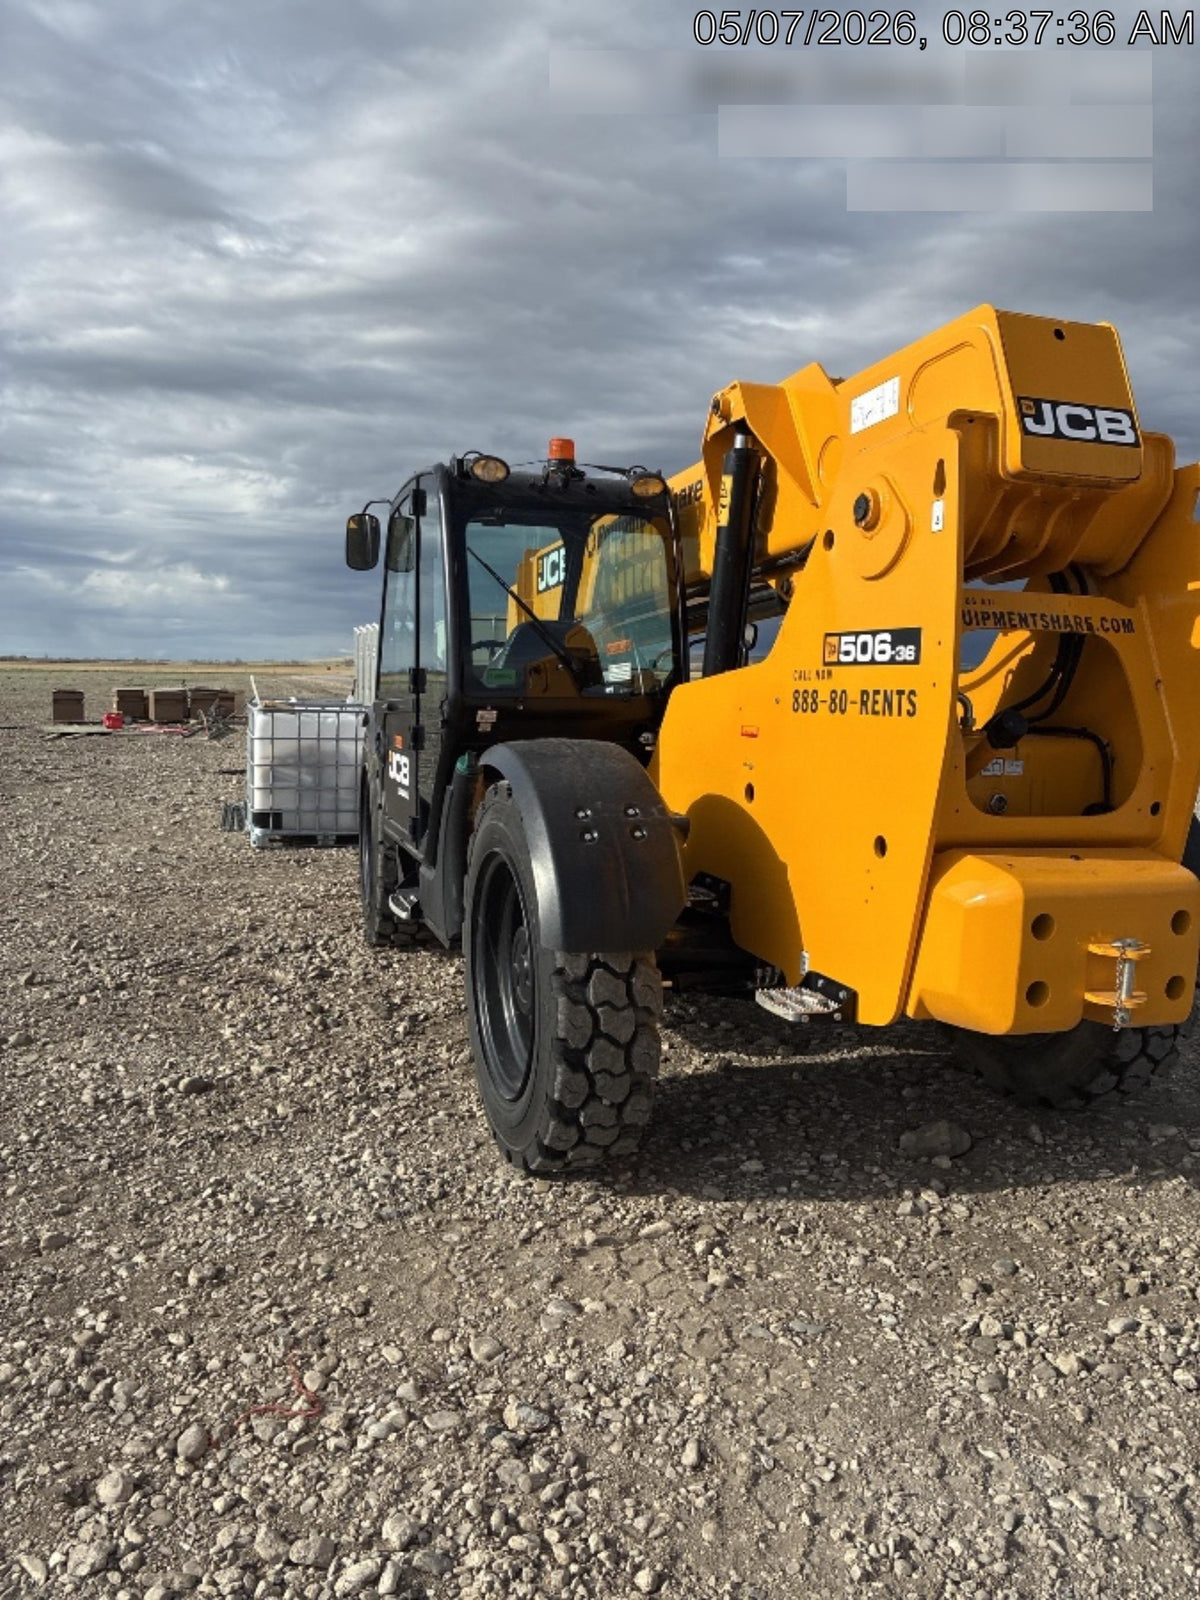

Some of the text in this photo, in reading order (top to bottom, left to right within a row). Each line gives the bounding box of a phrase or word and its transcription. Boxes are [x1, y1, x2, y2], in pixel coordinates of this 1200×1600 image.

[1023, 402, 1136, 444] JCB
[839, 632, 916, 663] 506-36
[792, 689, 917, 718] 888-80-RENTS
[388, 750, 410, 786] JCB
